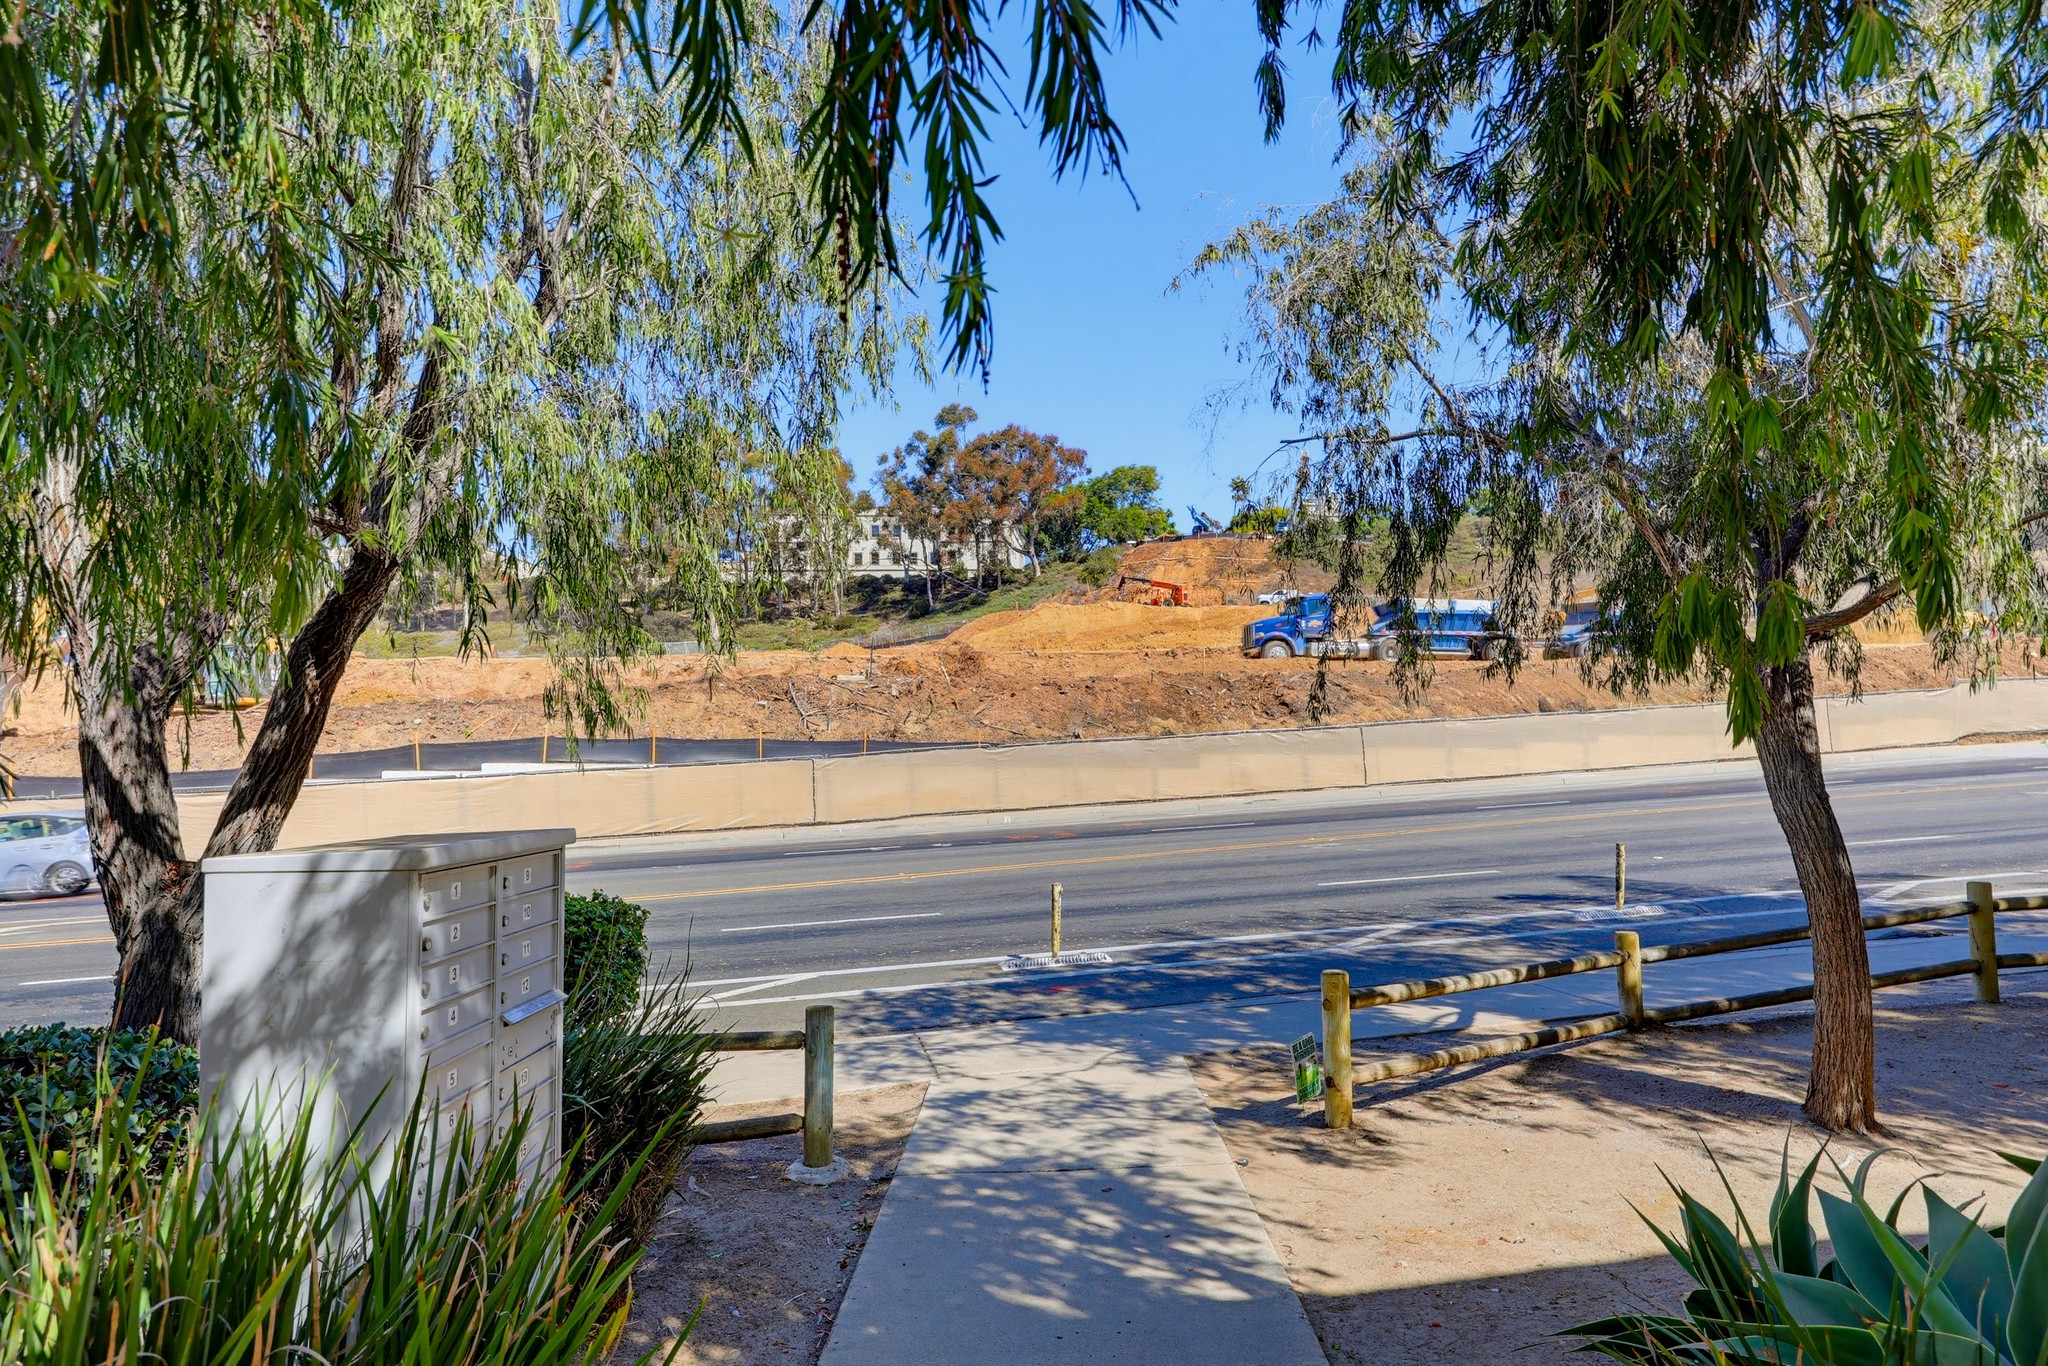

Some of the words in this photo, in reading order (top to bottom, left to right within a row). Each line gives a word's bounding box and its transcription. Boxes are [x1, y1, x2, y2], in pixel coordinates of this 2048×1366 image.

[526, 870, 530, 880] 9
[454, 886, 458, 896] 1
[524, 907, 530, 918] 10
[453, 927, 458, 939] 2
[523, 943, 530, 954] 11
[453, 968, 457, 980] 3
[523, 980, 529, 991] 12
[451, 1009, 456, 1021] 4
[450, 1072, 455, 1085] 5
[521, 1071, 527, 1083] 13
[449, 1114, 454, 1126] 6
